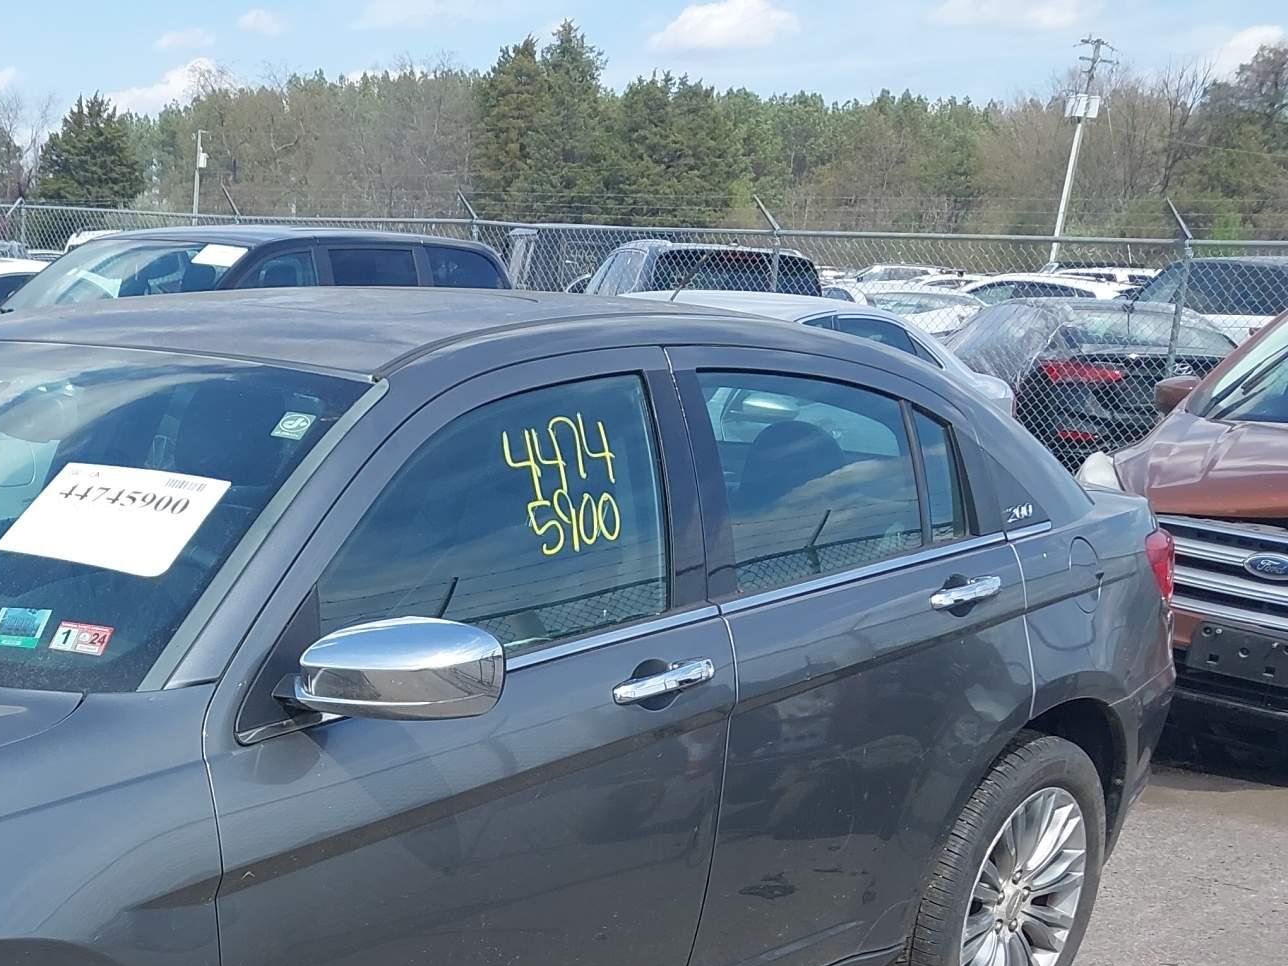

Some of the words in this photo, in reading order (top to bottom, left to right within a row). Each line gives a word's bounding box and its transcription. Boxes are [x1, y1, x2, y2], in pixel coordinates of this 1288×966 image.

[502, 412, 616, 501] 4474
[59, 483, 191, 515] 44745900
[527, 488, 621, 556] 5900
[61, 629, 72, 645] 1
[89, 632, 108, 646] 24
